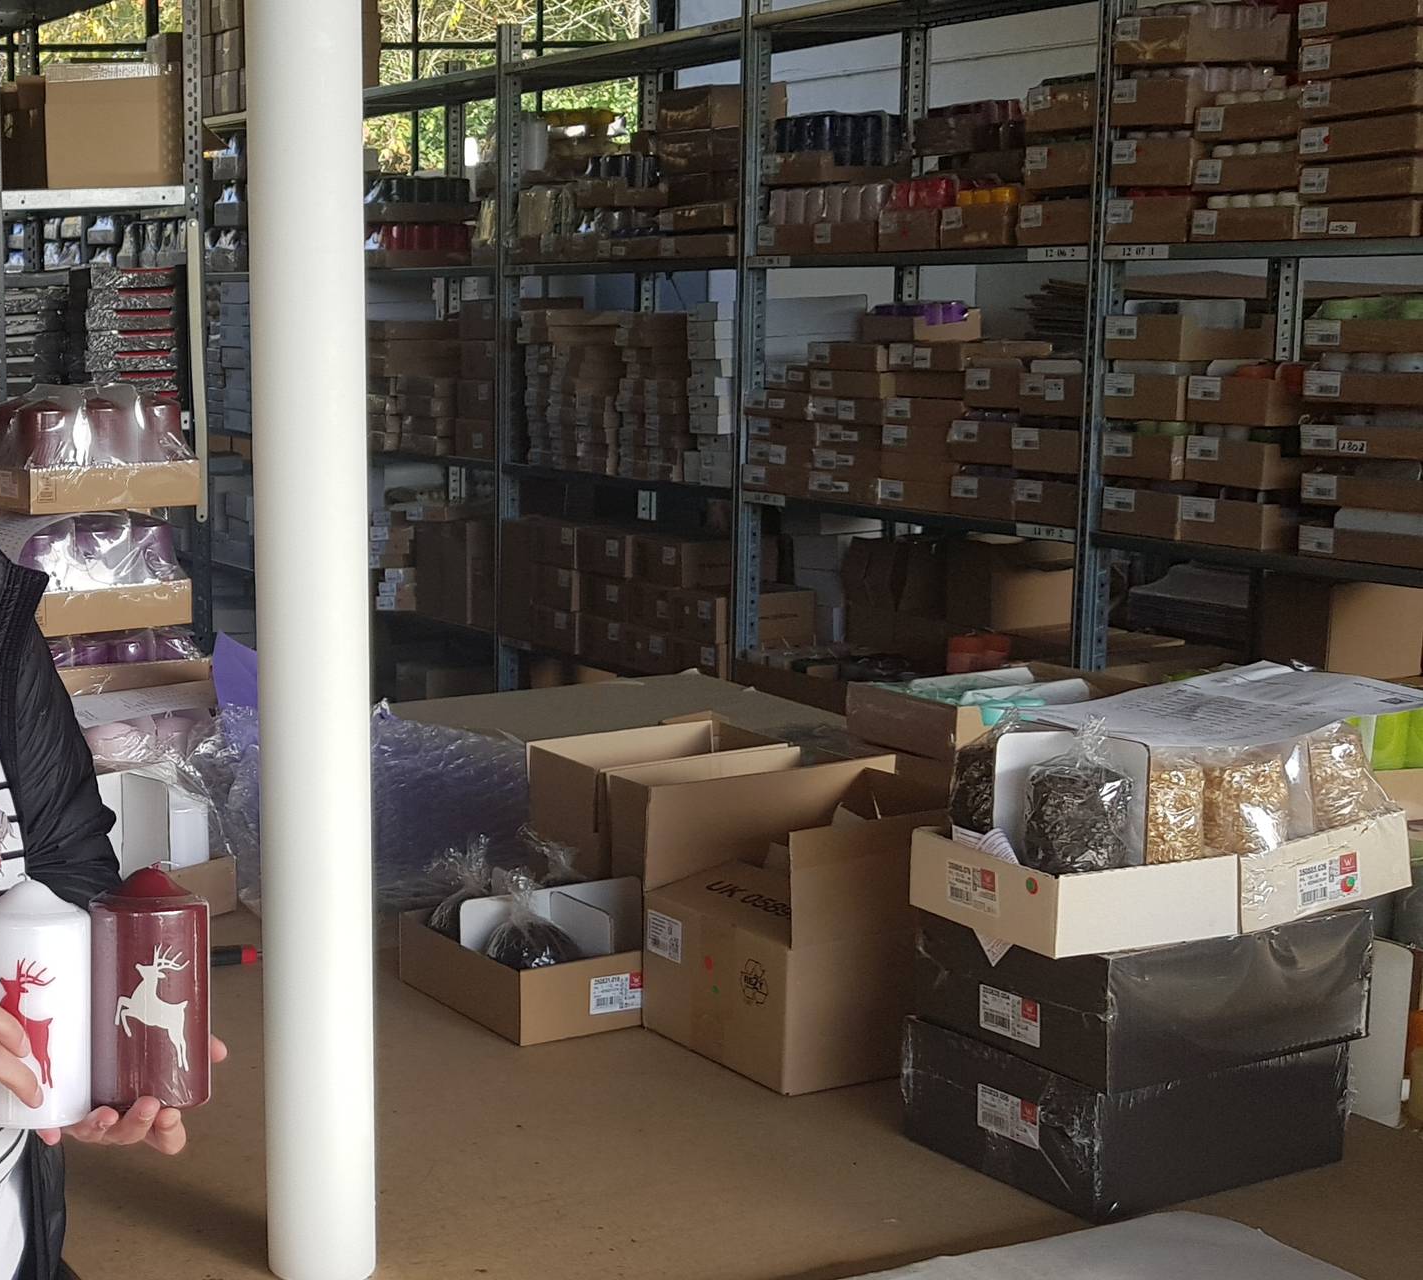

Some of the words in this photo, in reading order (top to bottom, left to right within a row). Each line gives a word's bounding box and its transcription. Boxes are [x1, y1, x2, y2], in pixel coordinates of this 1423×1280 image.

[1122, 247, 1131, 256] 12
[1135, 246, 1146, 256] 07
[706, 881, 748, 898] UK
